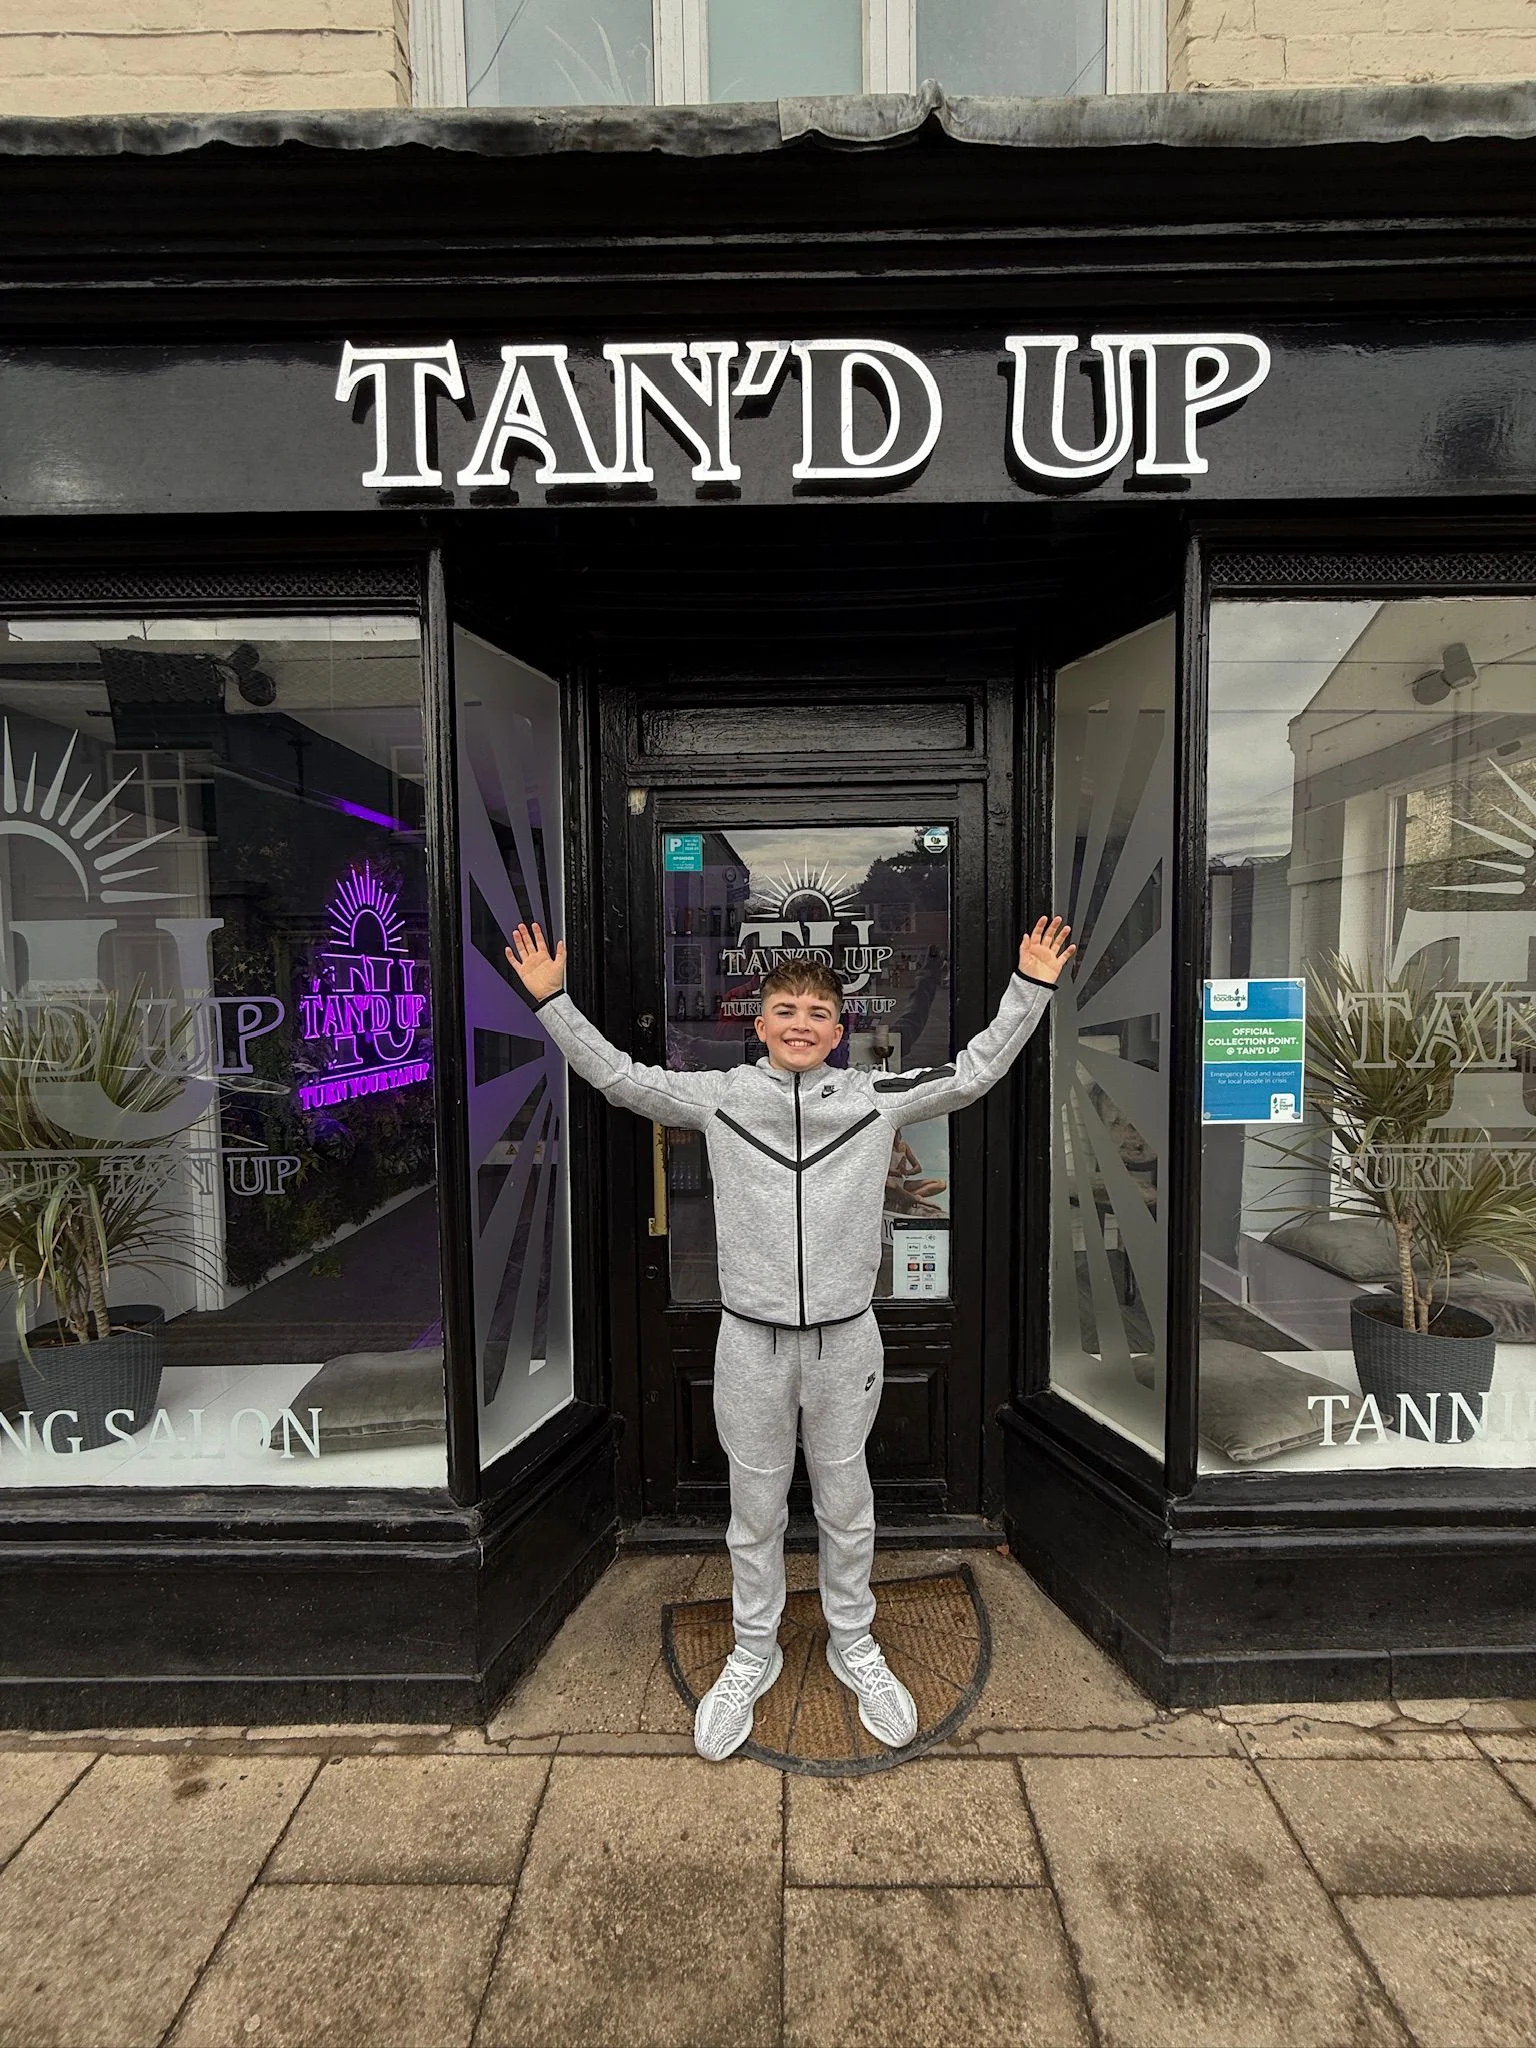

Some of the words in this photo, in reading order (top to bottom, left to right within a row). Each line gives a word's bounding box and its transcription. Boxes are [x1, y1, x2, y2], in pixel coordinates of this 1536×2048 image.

[335, 339, 945, 488] TAN'D
[1005, 333, 1272, 480] UP
[670, 838, 682, 852] P
[845, 946, 893, 973] UP
[395, 994, 426, 1030] UP
[841, 1000, 868, 1014] AN
[872, 999, 897, 1013] UP
[137, 996, 286, 1078] UP
[1207, 1038, 1266, 1046] COLLECTION
[1268, 1037, 1299, 1045] POINT.
[1232, 1027, 1275, 1036] OFFICIAL
[1226, 1047, 1235, 1055] @
[1236, 1047, 1265, 1055] TAN'D
[1266, 1046, 1280, 1054] UP
[1210, 1071, 1243, 1079] Emergency
[1244, 1070, 1258, 1078] food
[1272, 1070, 1295, 1078] support
[299, 1080, 347, 1111] TURN
[349, 1071, 389, 1099] YOUR
[227, 1155, 301, 1197] UP
[1329, 1152, 1475, 1192] TURN
[104, 1407, 323, 1460] SALON
